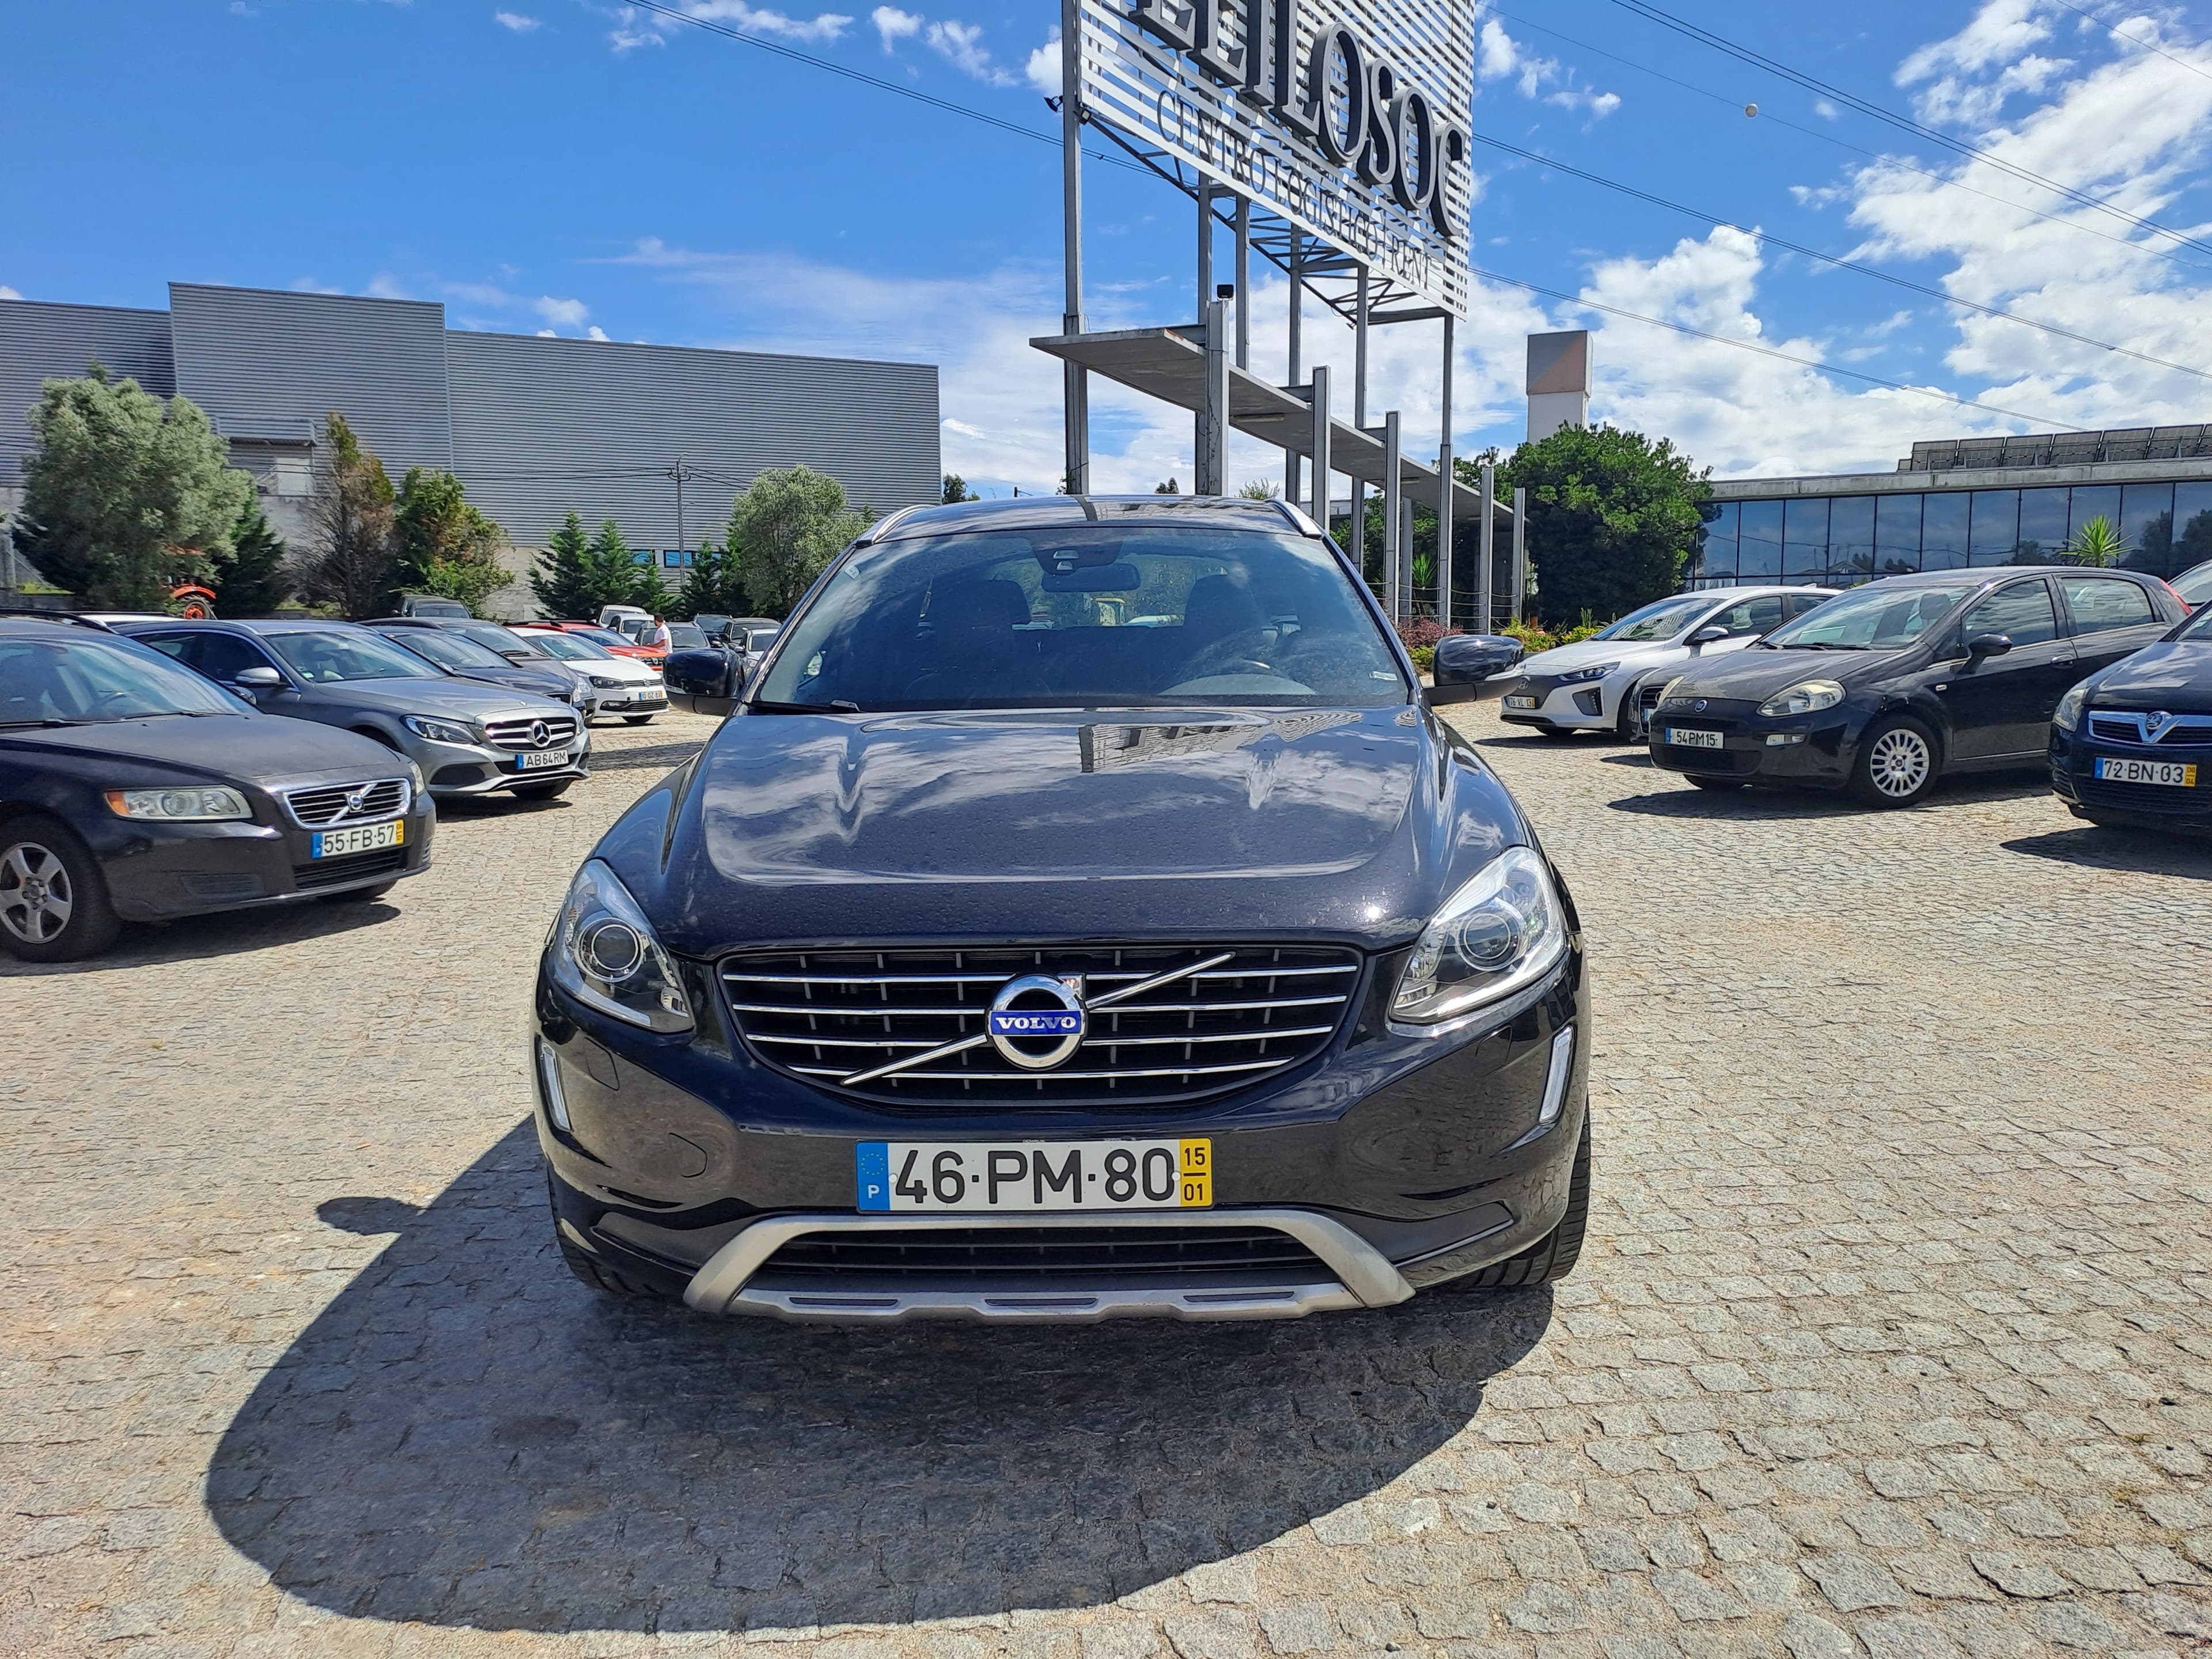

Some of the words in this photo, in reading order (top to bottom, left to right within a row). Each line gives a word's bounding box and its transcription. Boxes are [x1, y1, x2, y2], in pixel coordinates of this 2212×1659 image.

[1128, 0, 1465, 237] ILOSOC
[1157, 90, 1266, 194] CENTRO
[995, 1016, 1077, 1030] VOLVO
[1184, 1146, 1206, 1166] 15
[867, 1184, 880, 1199] P
[1184, 1183, 1203, 1201] 01
